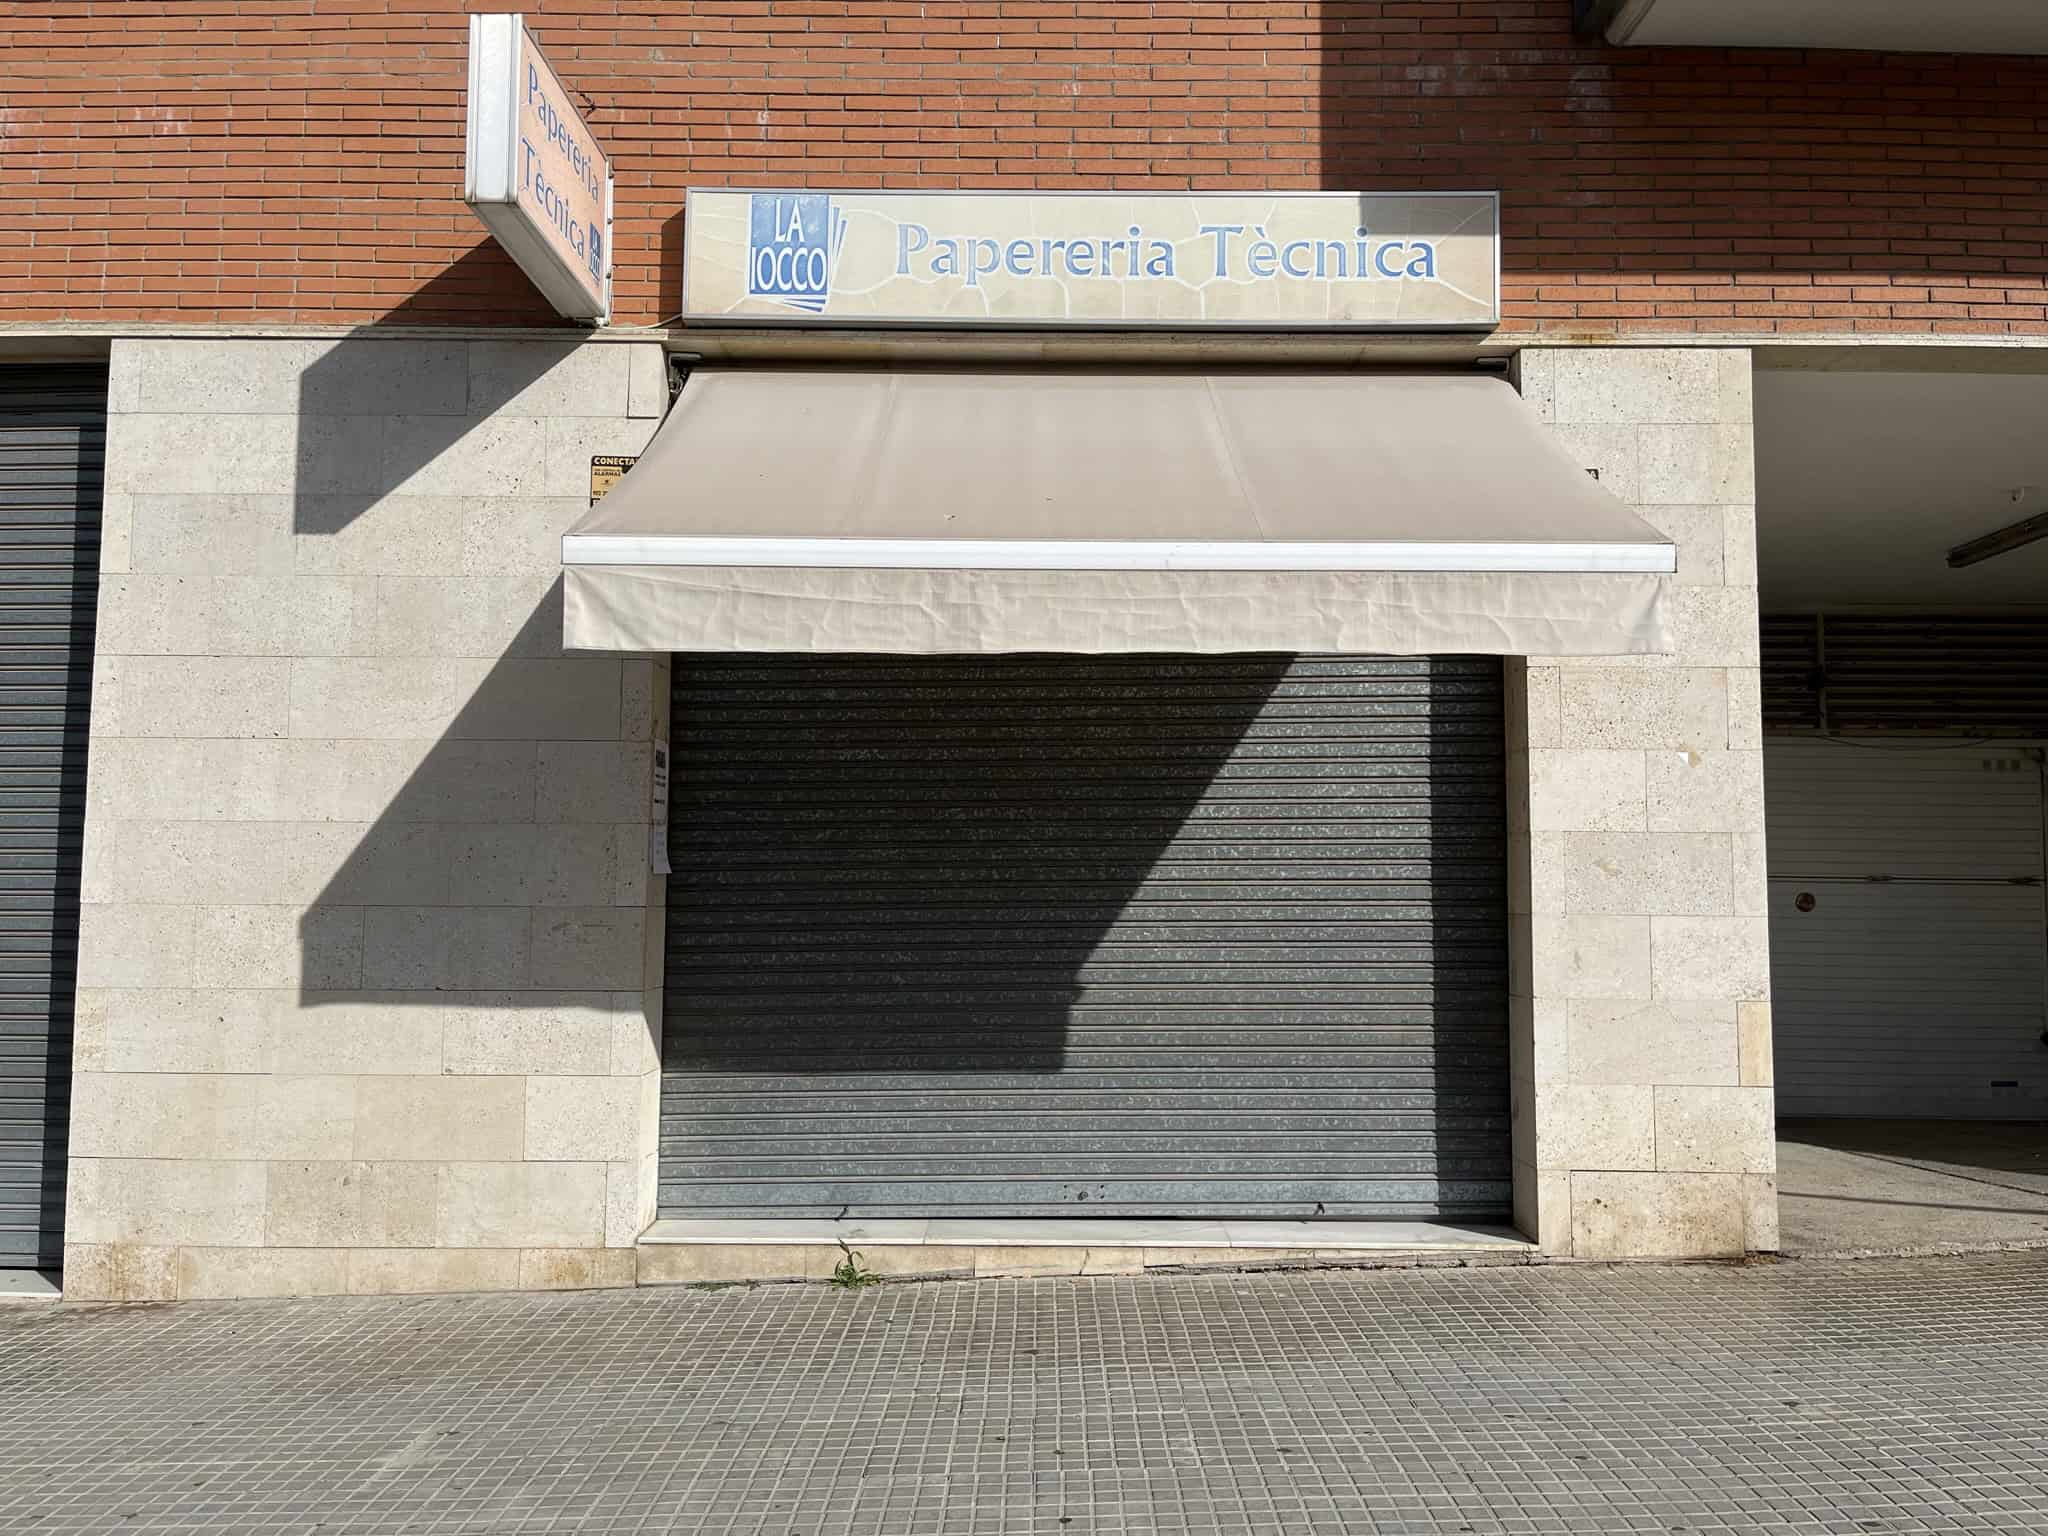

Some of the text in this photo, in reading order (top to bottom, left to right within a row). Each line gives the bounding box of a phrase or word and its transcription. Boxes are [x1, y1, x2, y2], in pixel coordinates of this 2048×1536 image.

[527, 63, 599, 202] Papereria
[521, 137, 585, 260] Tècnica
[775, 198, 805, 242] LA
[898, 224, 1437, 286] Papereria Tècnica
